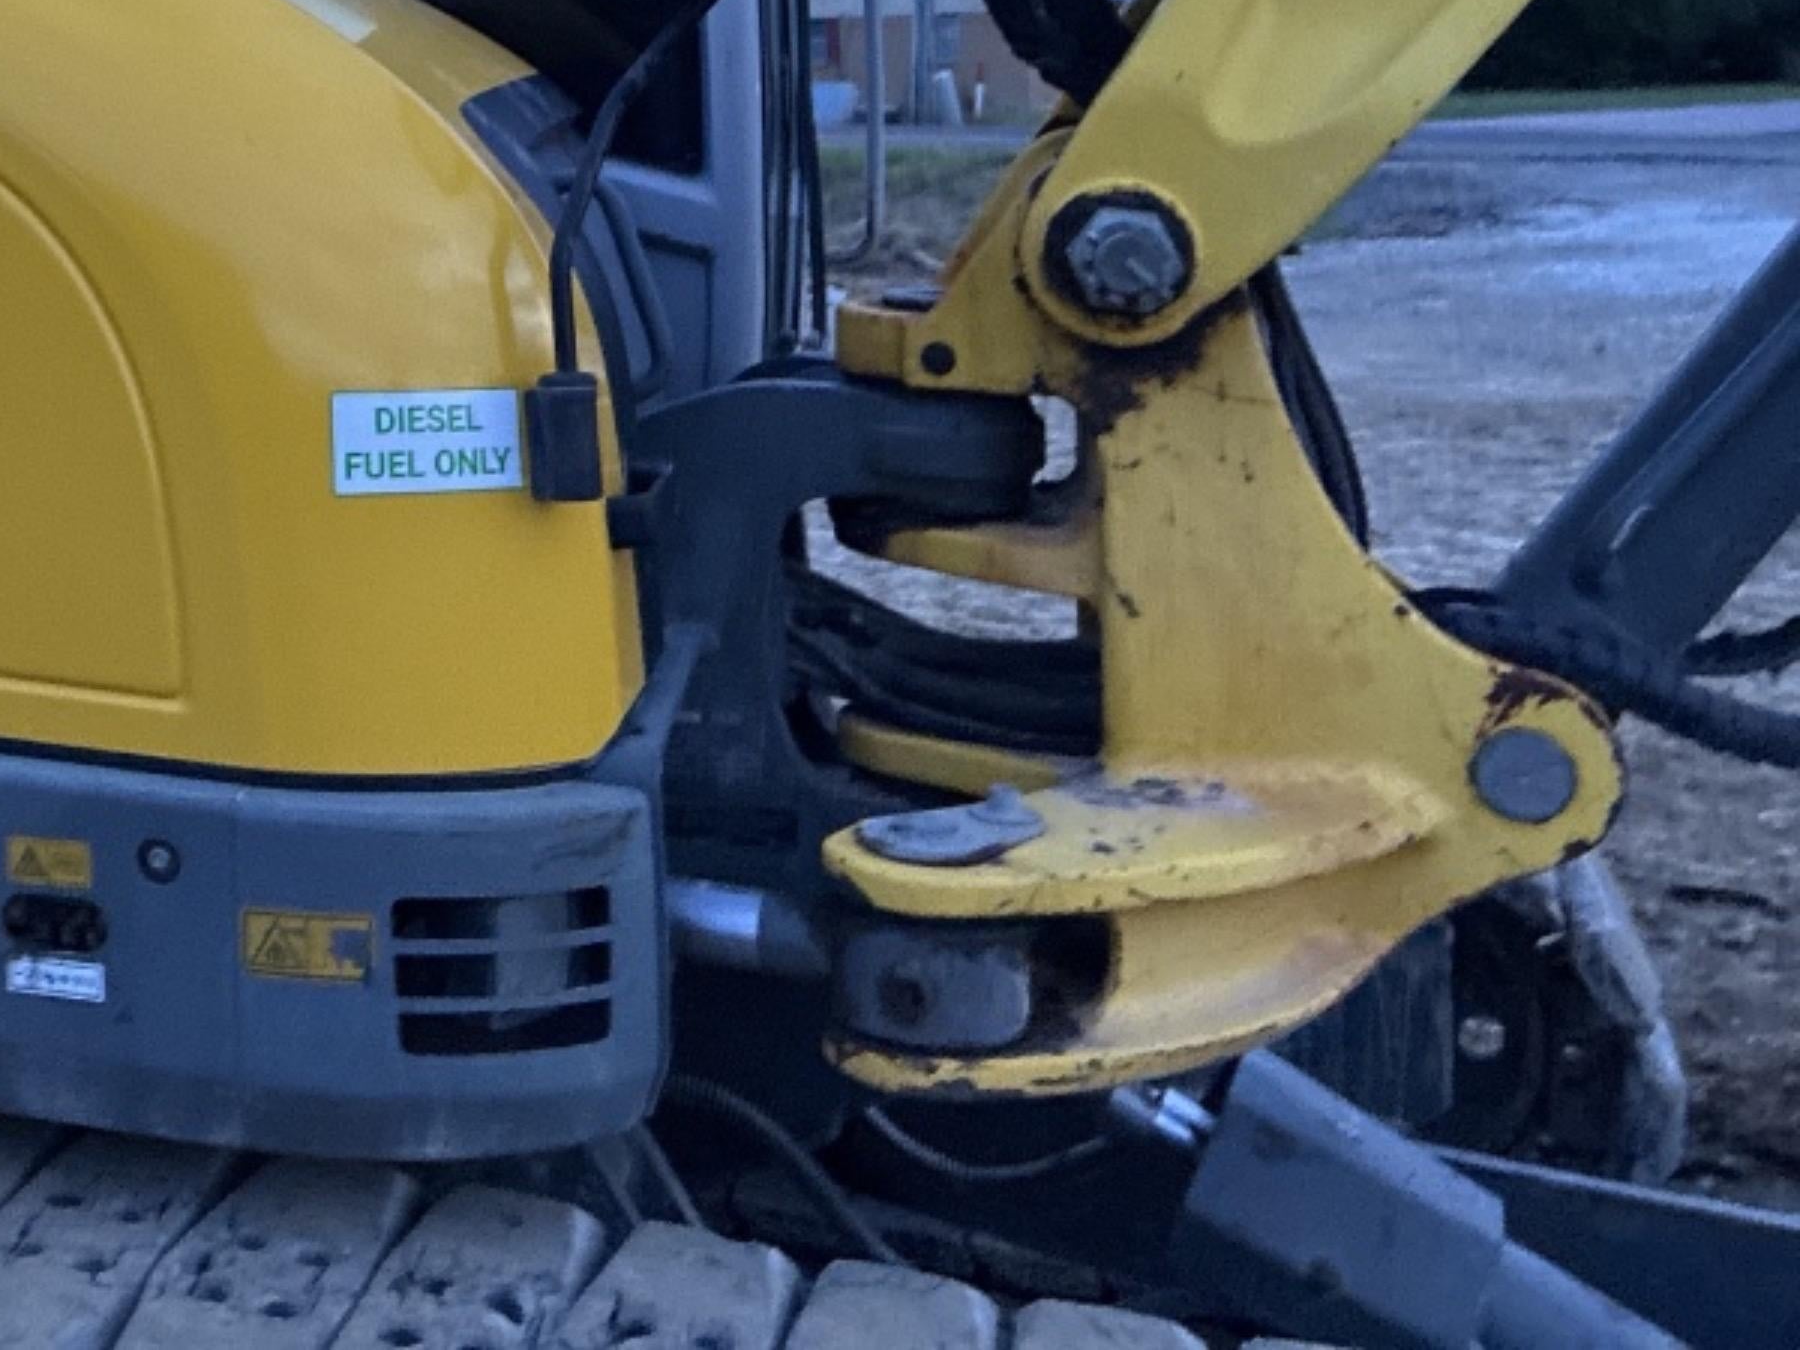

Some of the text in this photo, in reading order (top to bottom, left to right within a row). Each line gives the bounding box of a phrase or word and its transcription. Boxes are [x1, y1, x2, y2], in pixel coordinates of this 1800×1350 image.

[373, 404, 484, 435] DIESEL
[343, 446, 512, 481] FUEL ONLY
